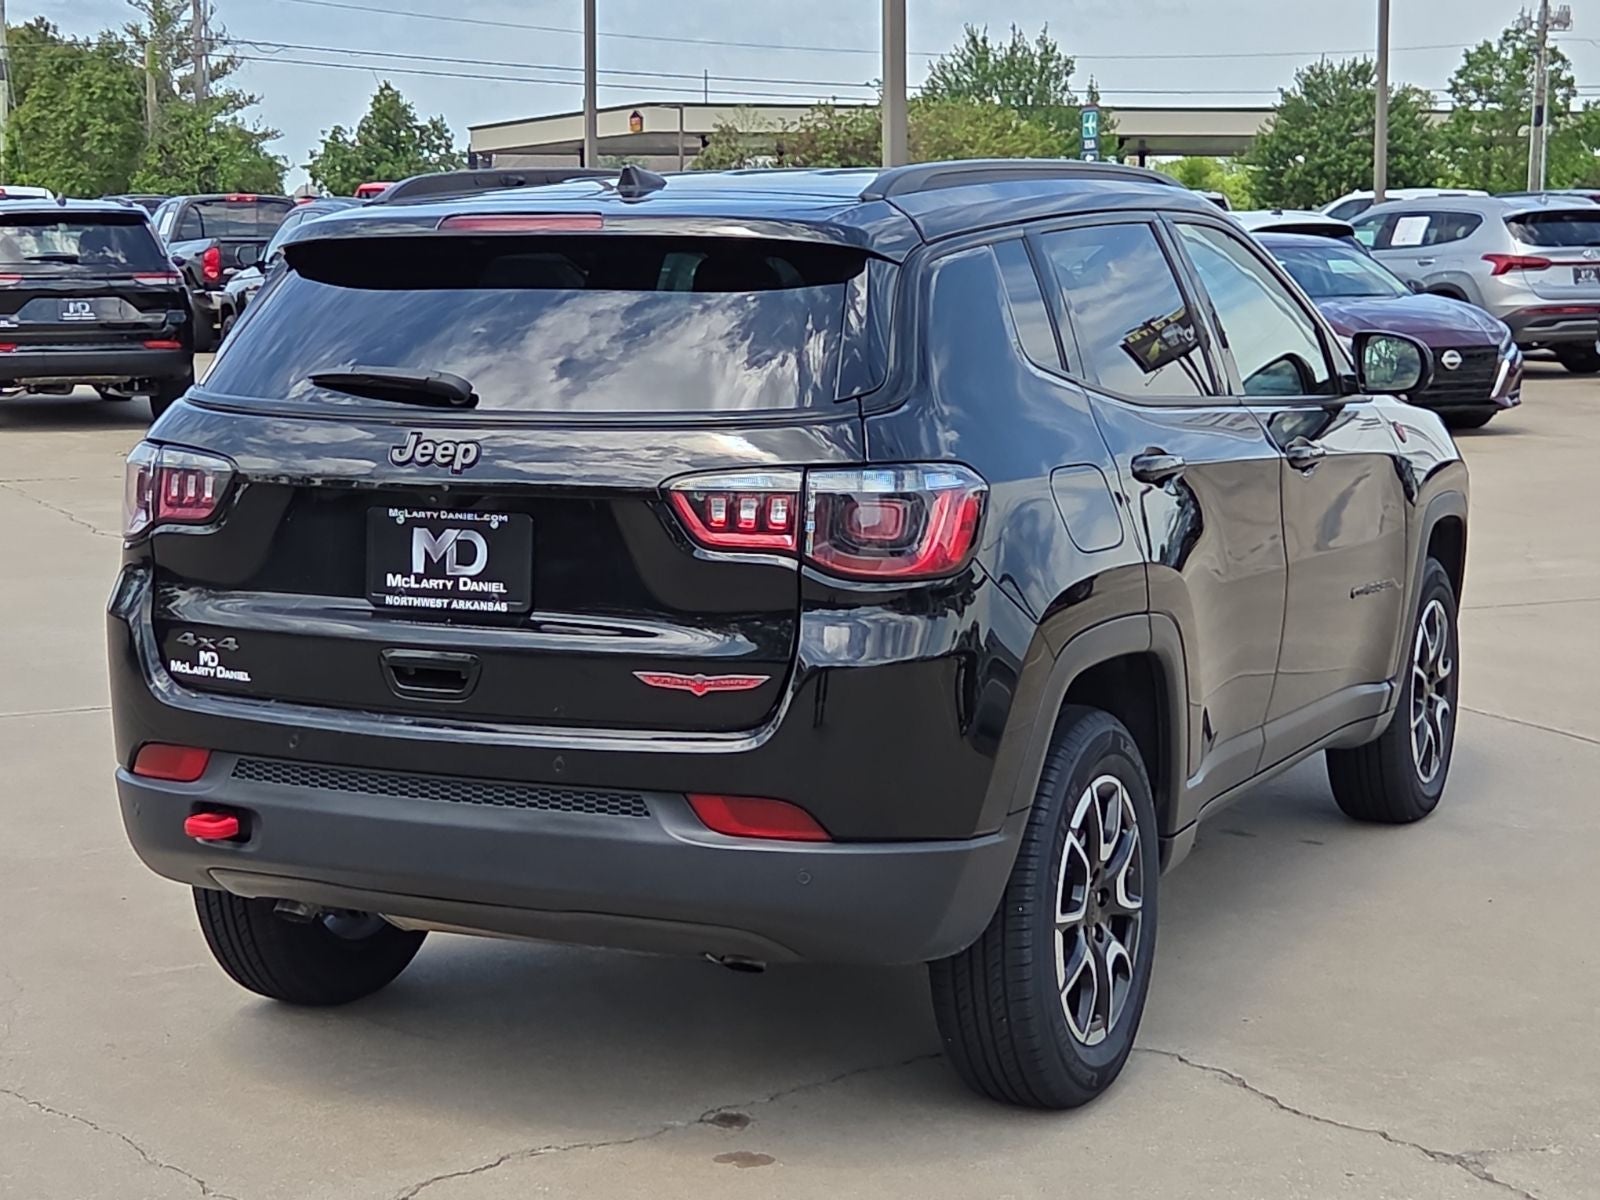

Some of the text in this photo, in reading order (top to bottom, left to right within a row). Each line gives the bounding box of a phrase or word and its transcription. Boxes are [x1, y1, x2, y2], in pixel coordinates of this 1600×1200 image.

[390, 432, 481, 474] Jeep
[412, 527, 488, 576] MD
[459, 577, 508, 593] DANIEL
[385, 595, 508, 612] NORTHWEST ARKANSAS
